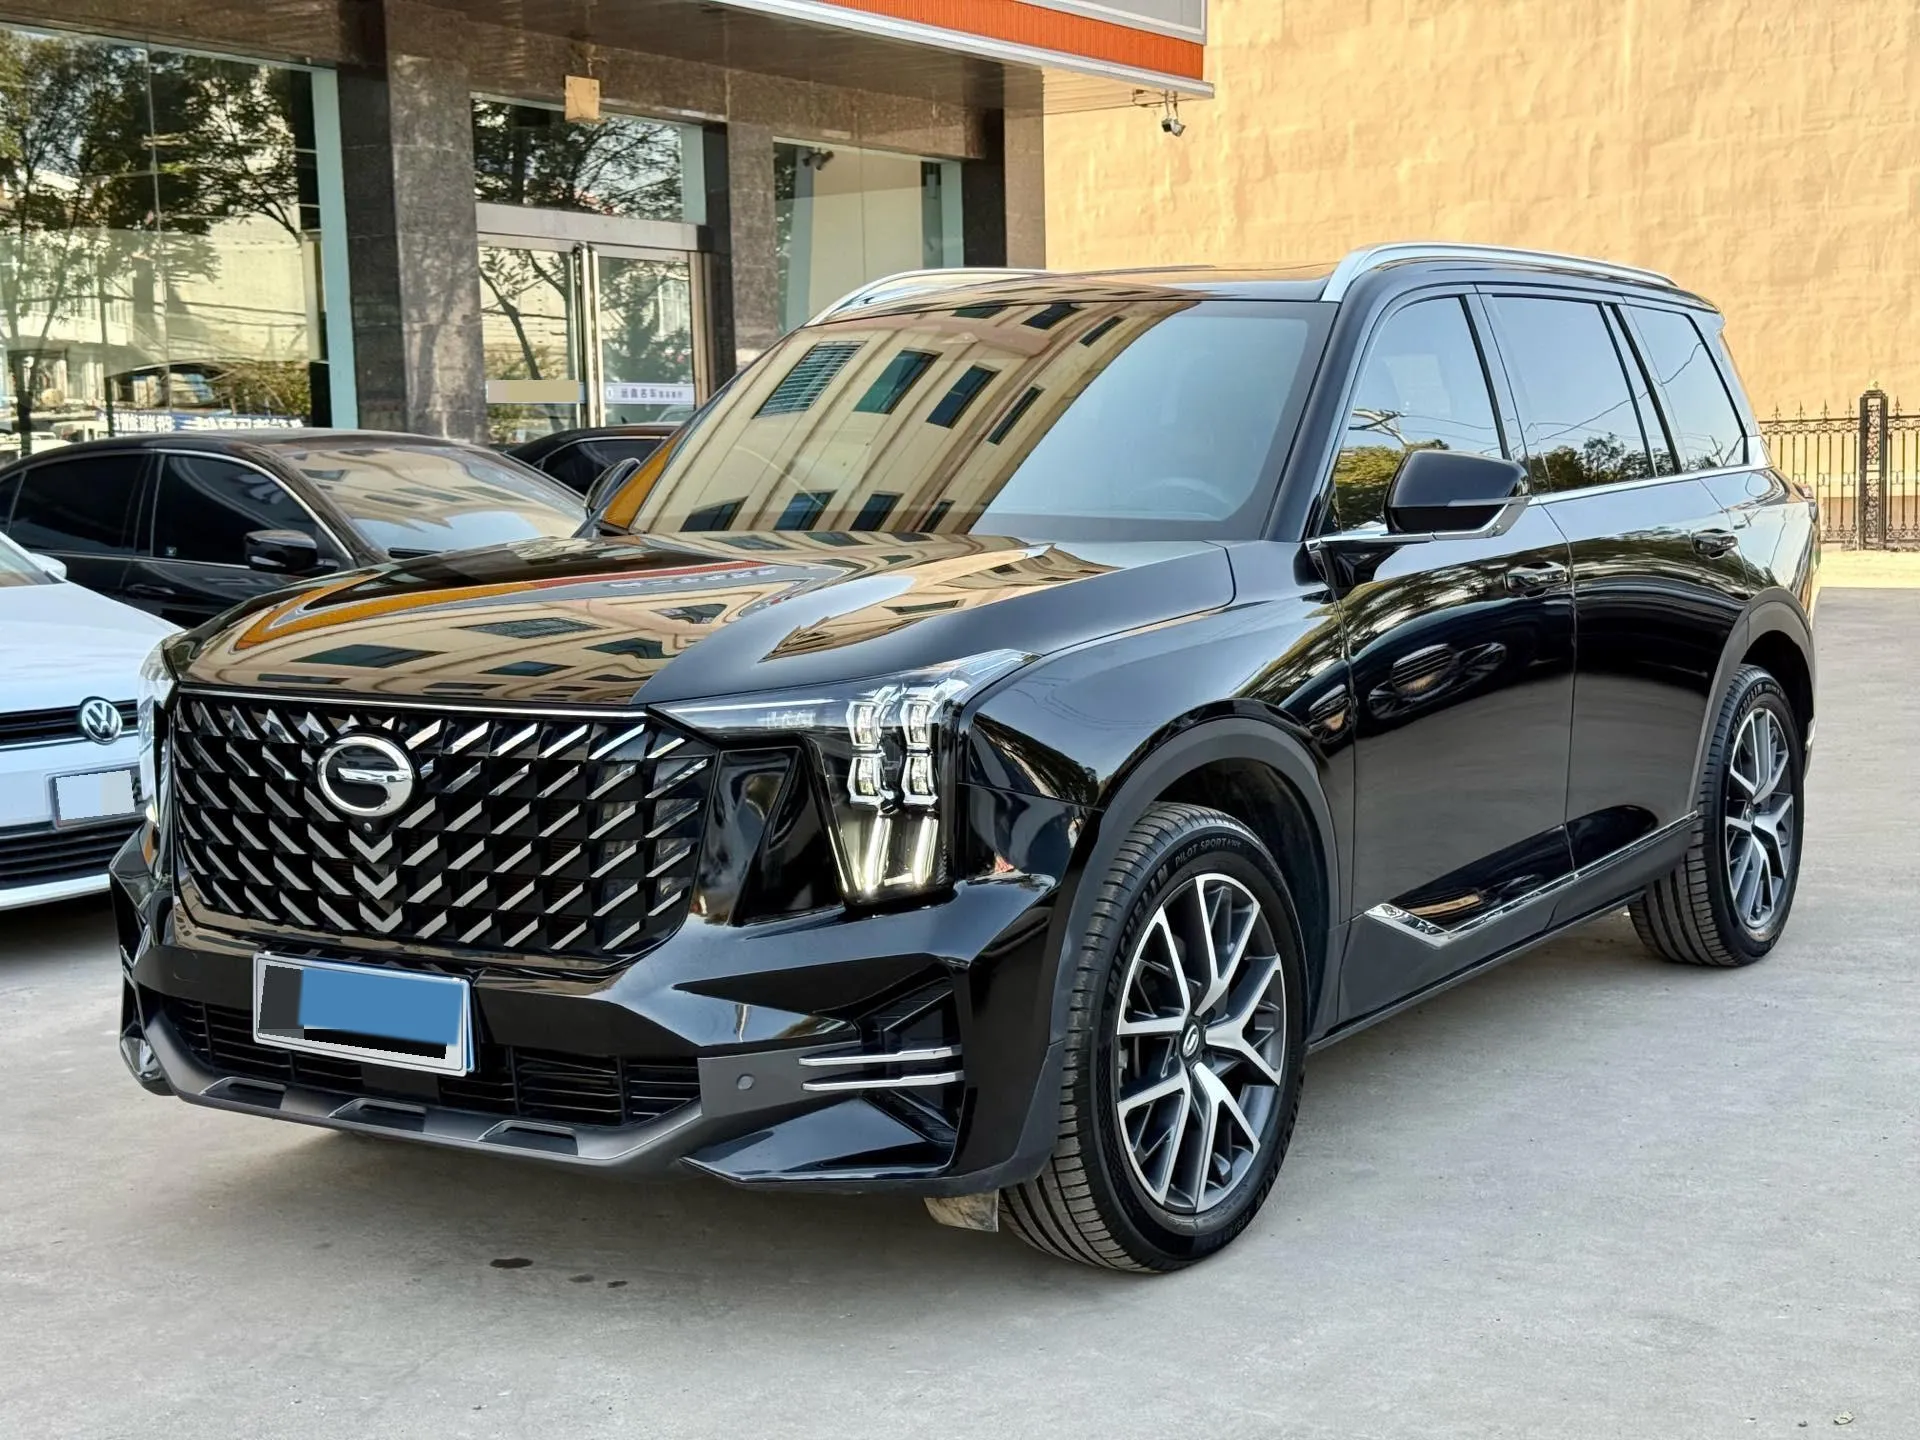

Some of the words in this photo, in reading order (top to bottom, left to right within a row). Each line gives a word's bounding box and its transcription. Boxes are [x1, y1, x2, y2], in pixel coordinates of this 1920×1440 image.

[1107, 864, 1170, 998] MICHELIN
[1175, 843, 1199, 867] PILOT
[1200, 837, 1227, 850] SPORT
